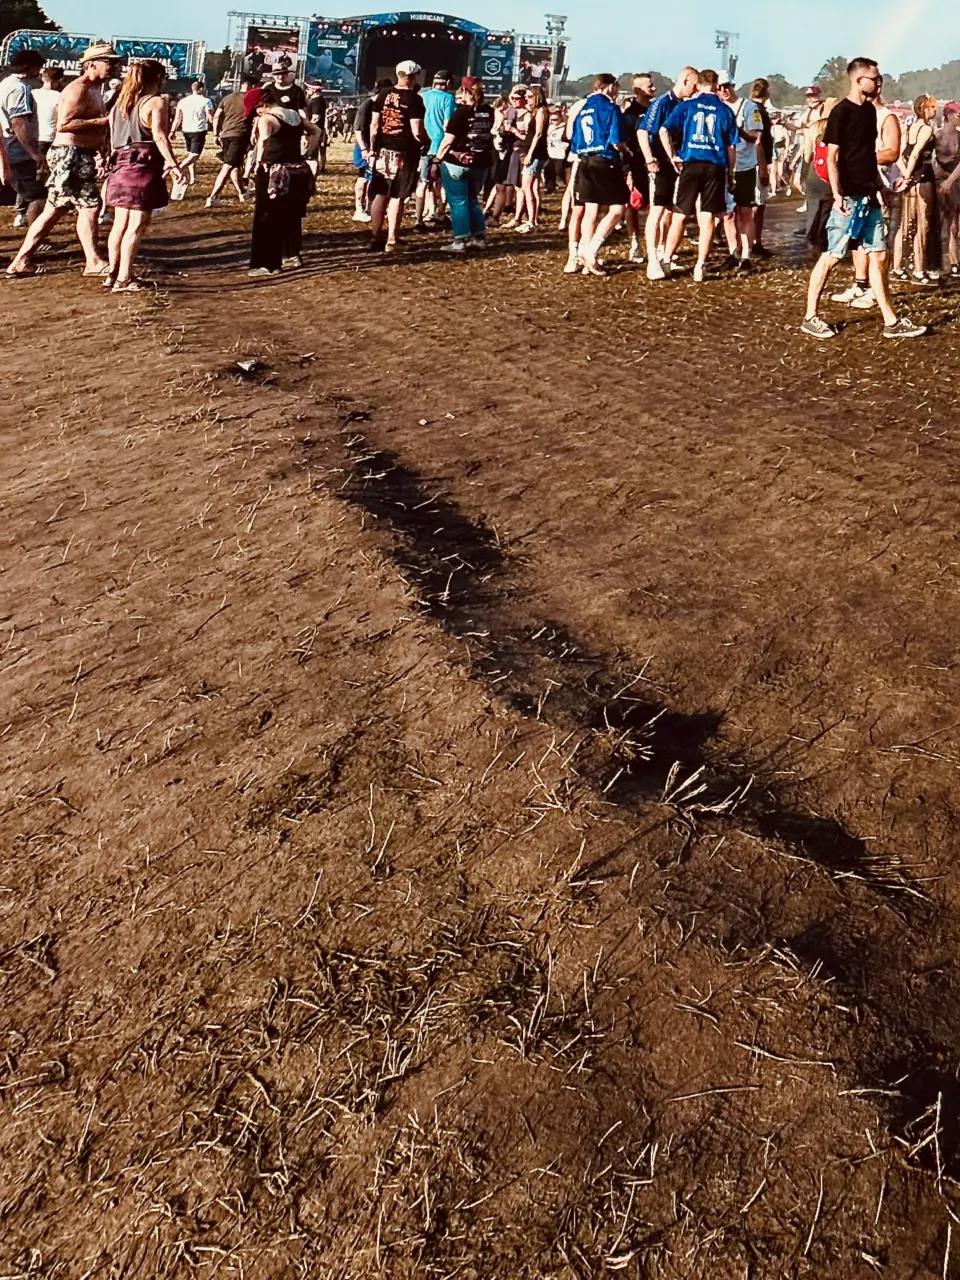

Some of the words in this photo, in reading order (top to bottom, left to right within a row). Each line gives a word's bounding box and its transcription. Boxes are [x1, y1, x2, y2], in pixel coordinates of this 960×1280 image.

[410, 14, 444, 23] HURRICANE
[580, 115, 594, 146] 6
[693, 111, 716, 144] 11
